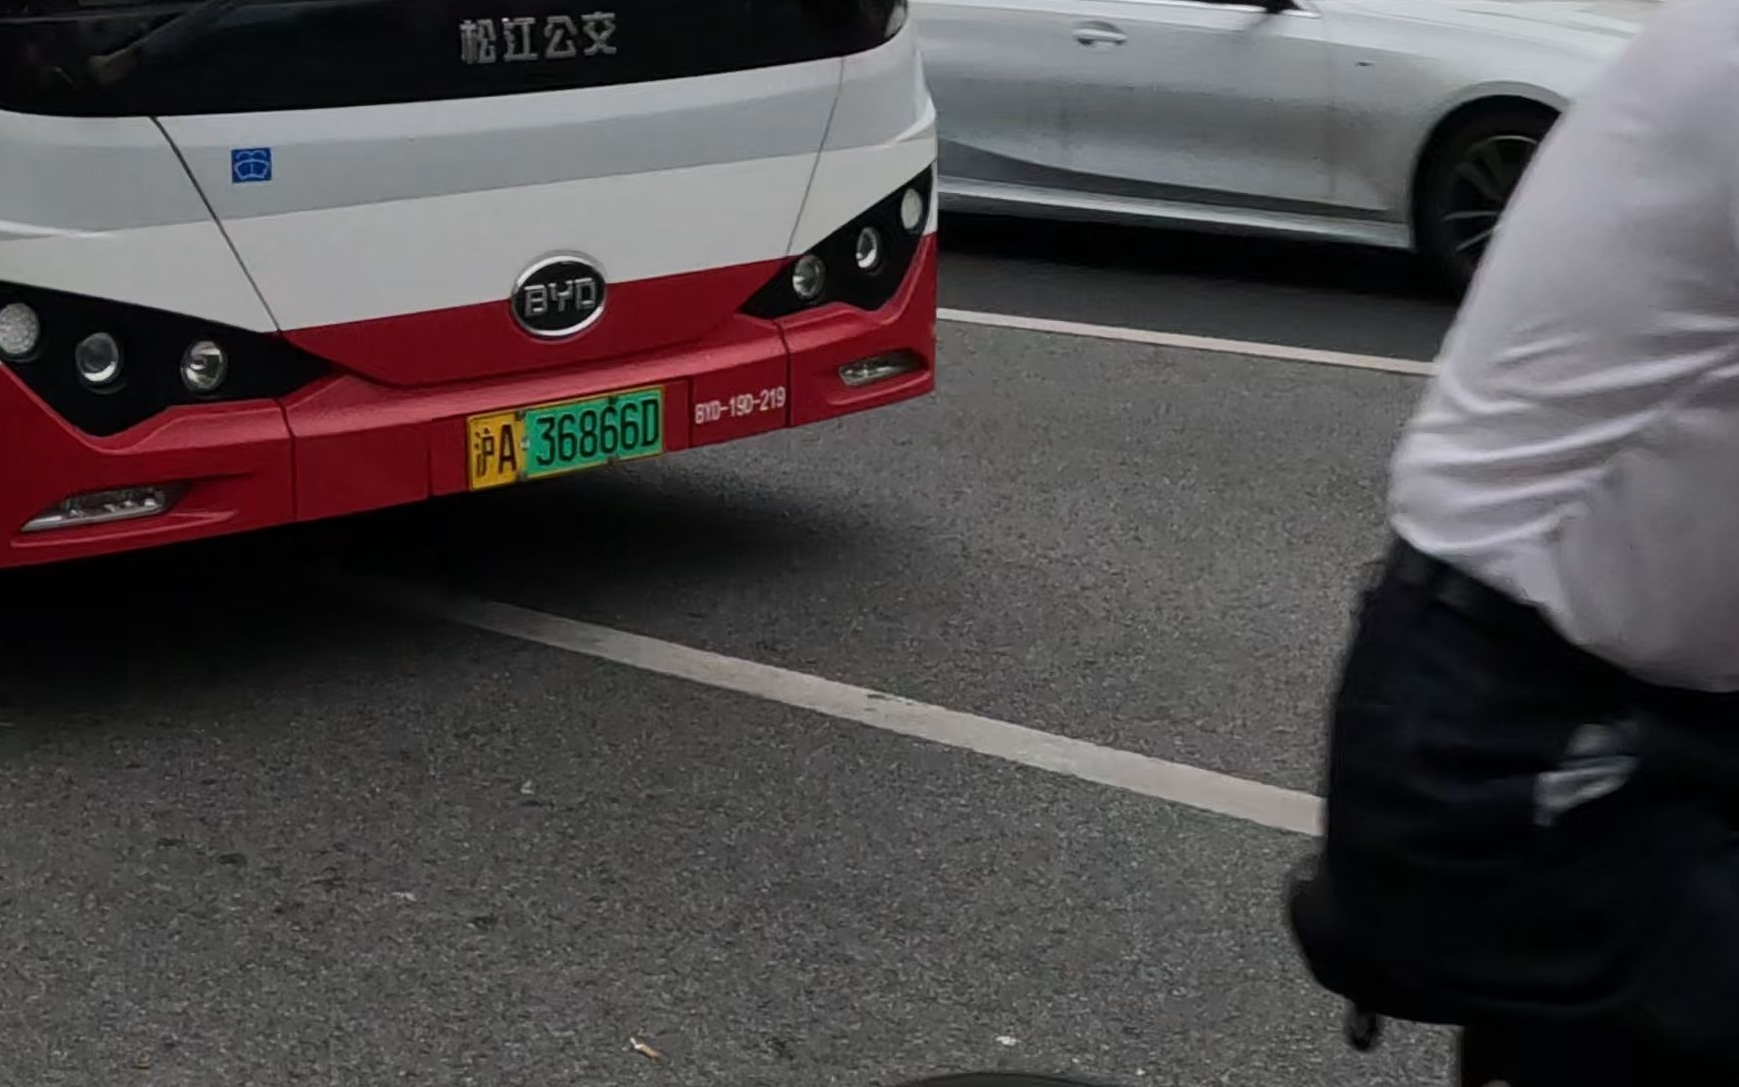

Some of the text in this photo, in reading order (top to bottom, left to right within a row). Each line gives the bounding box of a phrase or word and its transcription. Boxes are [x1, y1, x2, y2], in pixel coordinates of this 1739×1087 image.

[459, 11, 618, 65] 松江公交
[523, 277, 597, 317] BYD
